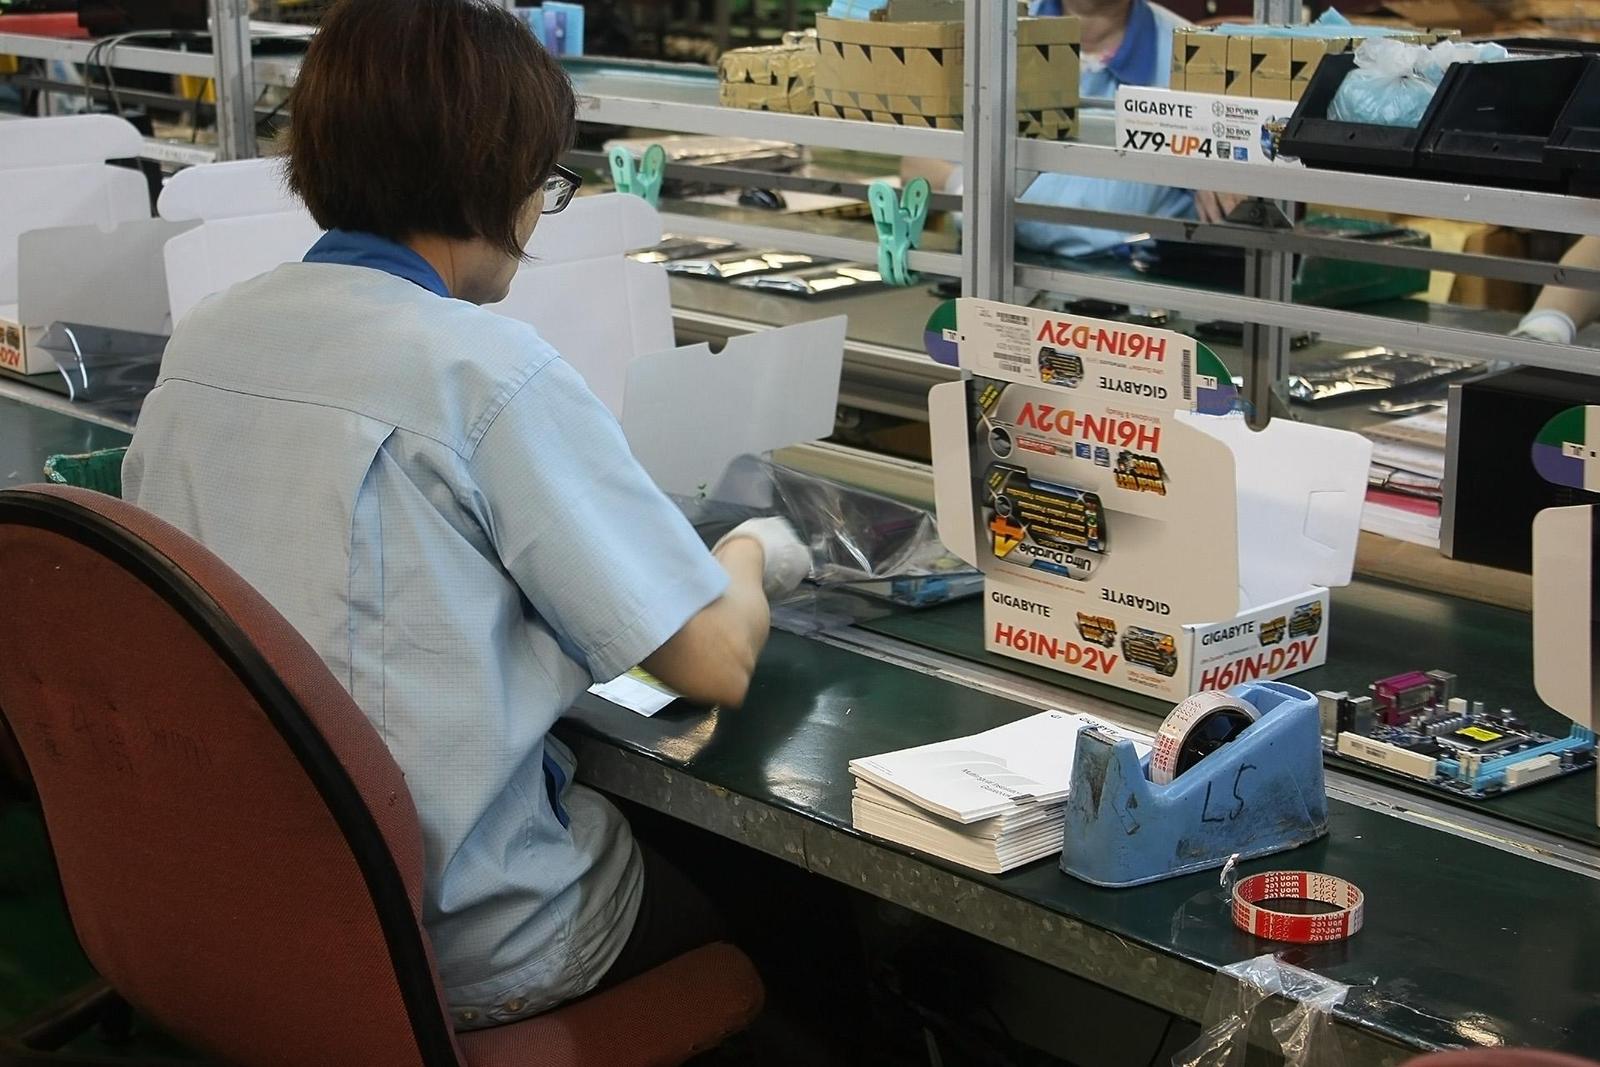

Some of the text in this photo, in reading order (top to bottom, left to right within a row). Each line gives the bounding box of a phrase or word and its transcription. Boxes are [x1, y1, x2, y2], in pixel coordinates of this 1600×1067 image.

[1124, 99, 1194, 119] GIGABYTE
[1123, 129, 1213, 158] X79-UP4
[1037, 319, 1167, 362] H61N-D2V
[1100, 377, 1168, 400] GIGABYTE
[1016, 402, 1162, 454] H61N-D2V
[1064, 554, 1092, 572] Ultra
[991, 591, 1051, 617] GIGABYTE
[1101, 588, 1171, 615] GIGABYTE
[1202, 620, 1255, 646] GIGABYTE
[994, 622, 1118, 675] H61N-D2V
[1199, 636, 1319, 692] H61N-D2V
